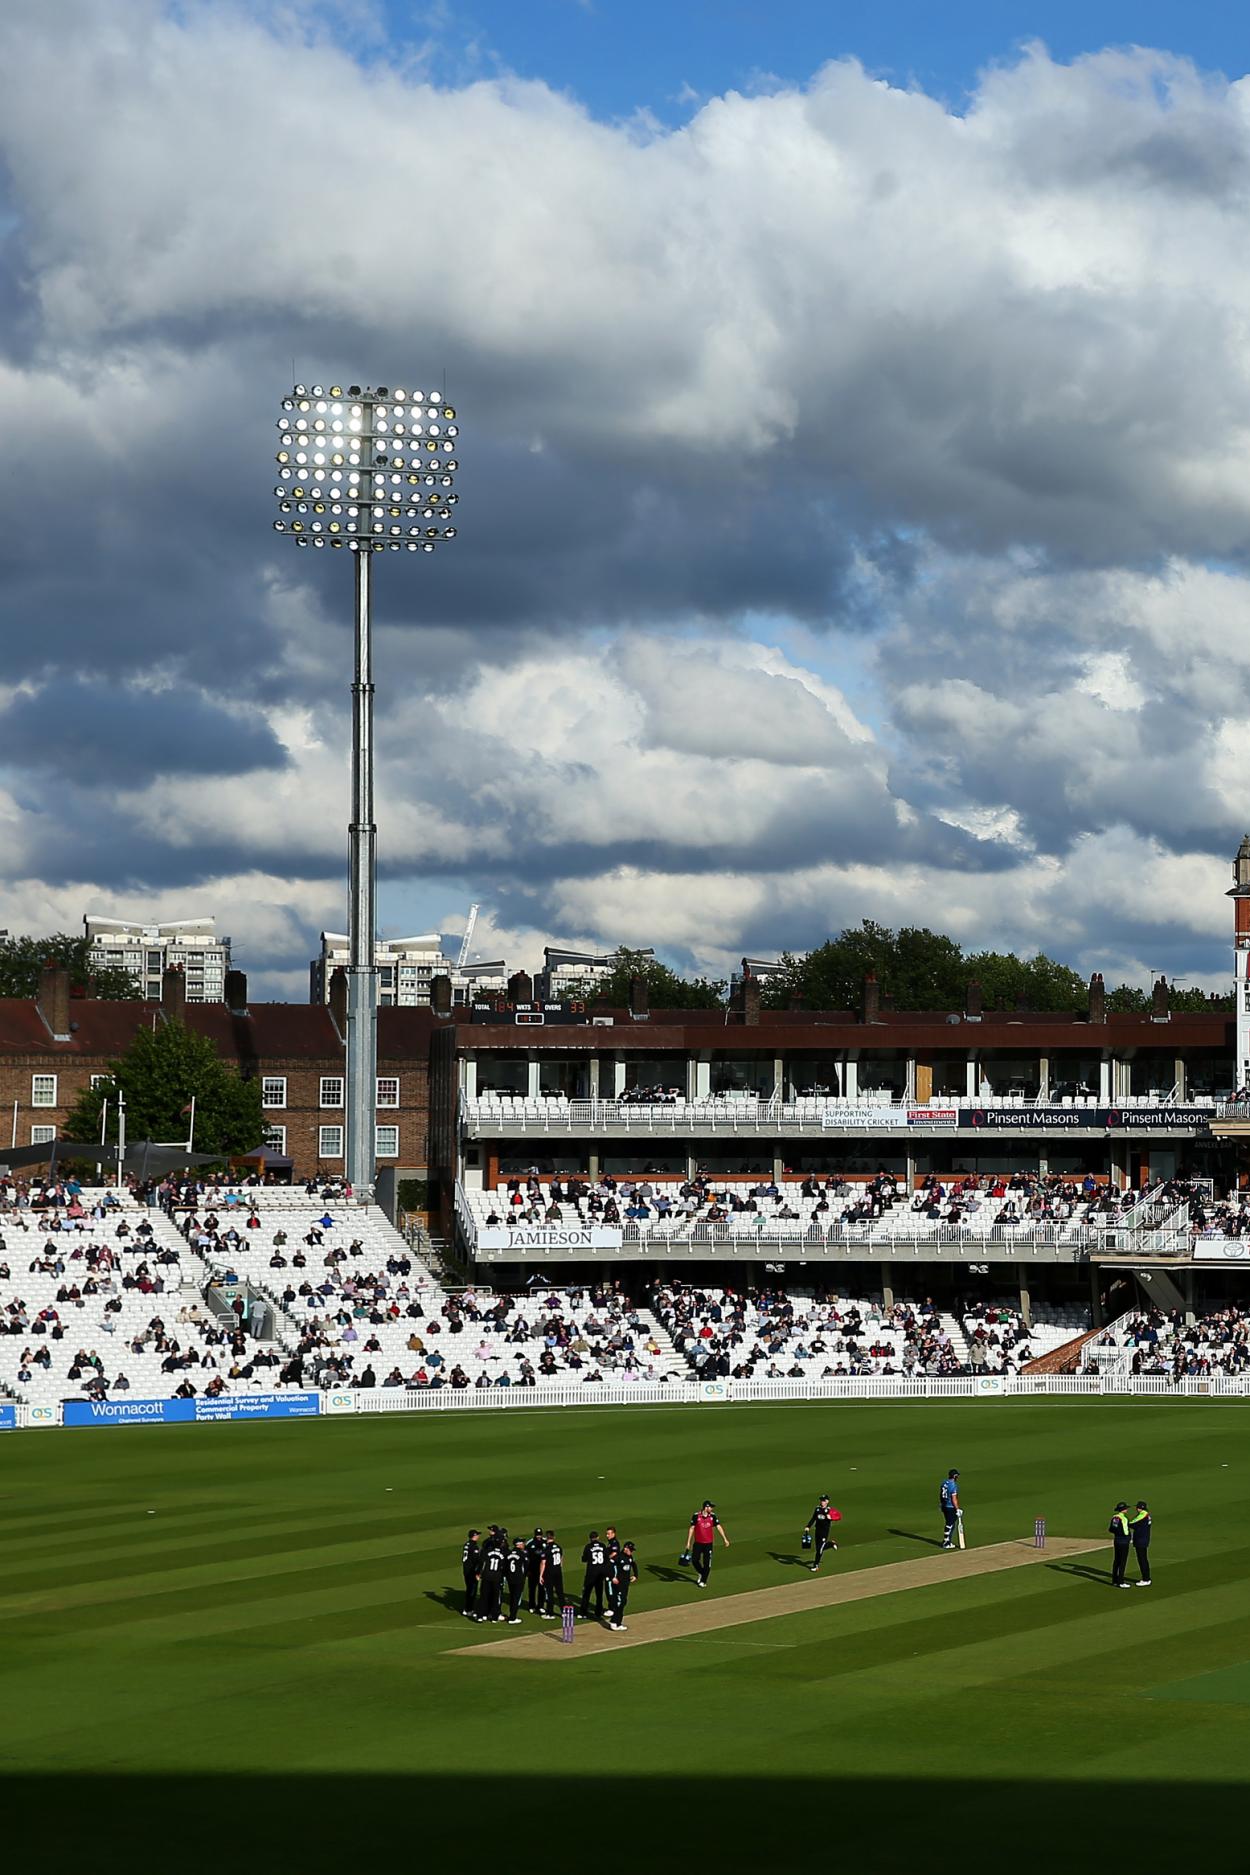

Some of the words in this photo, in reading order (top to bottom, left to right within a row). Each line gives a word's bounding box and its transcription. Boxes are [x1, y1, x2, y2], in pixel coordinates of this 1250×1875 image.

[825, 1110, 873, 1118] SUPPORTING
[908, 1111, 930, 1119] First
[932, 1110, 955, 1118] State
[987, 1112, 1031, 1124] Pinsent
[1033, 1112, 1079, 1124] Masons
[1122, 1111, 1165, 1123] Pinsent
[825, 1118, 865, 1126] DISABILITY
[867, 1118, 899, 1126] CRICKET
[508, 1231, 592, 1248] JAMIESON
[260, 1395, 274, 1403] and
[91, 1401, 164, 1417] Wonnacott
[592, 1551, 604, 1565] 58
[490, 1558, 499, 1571] 11
[510, 1560, 516, 1573] 6
